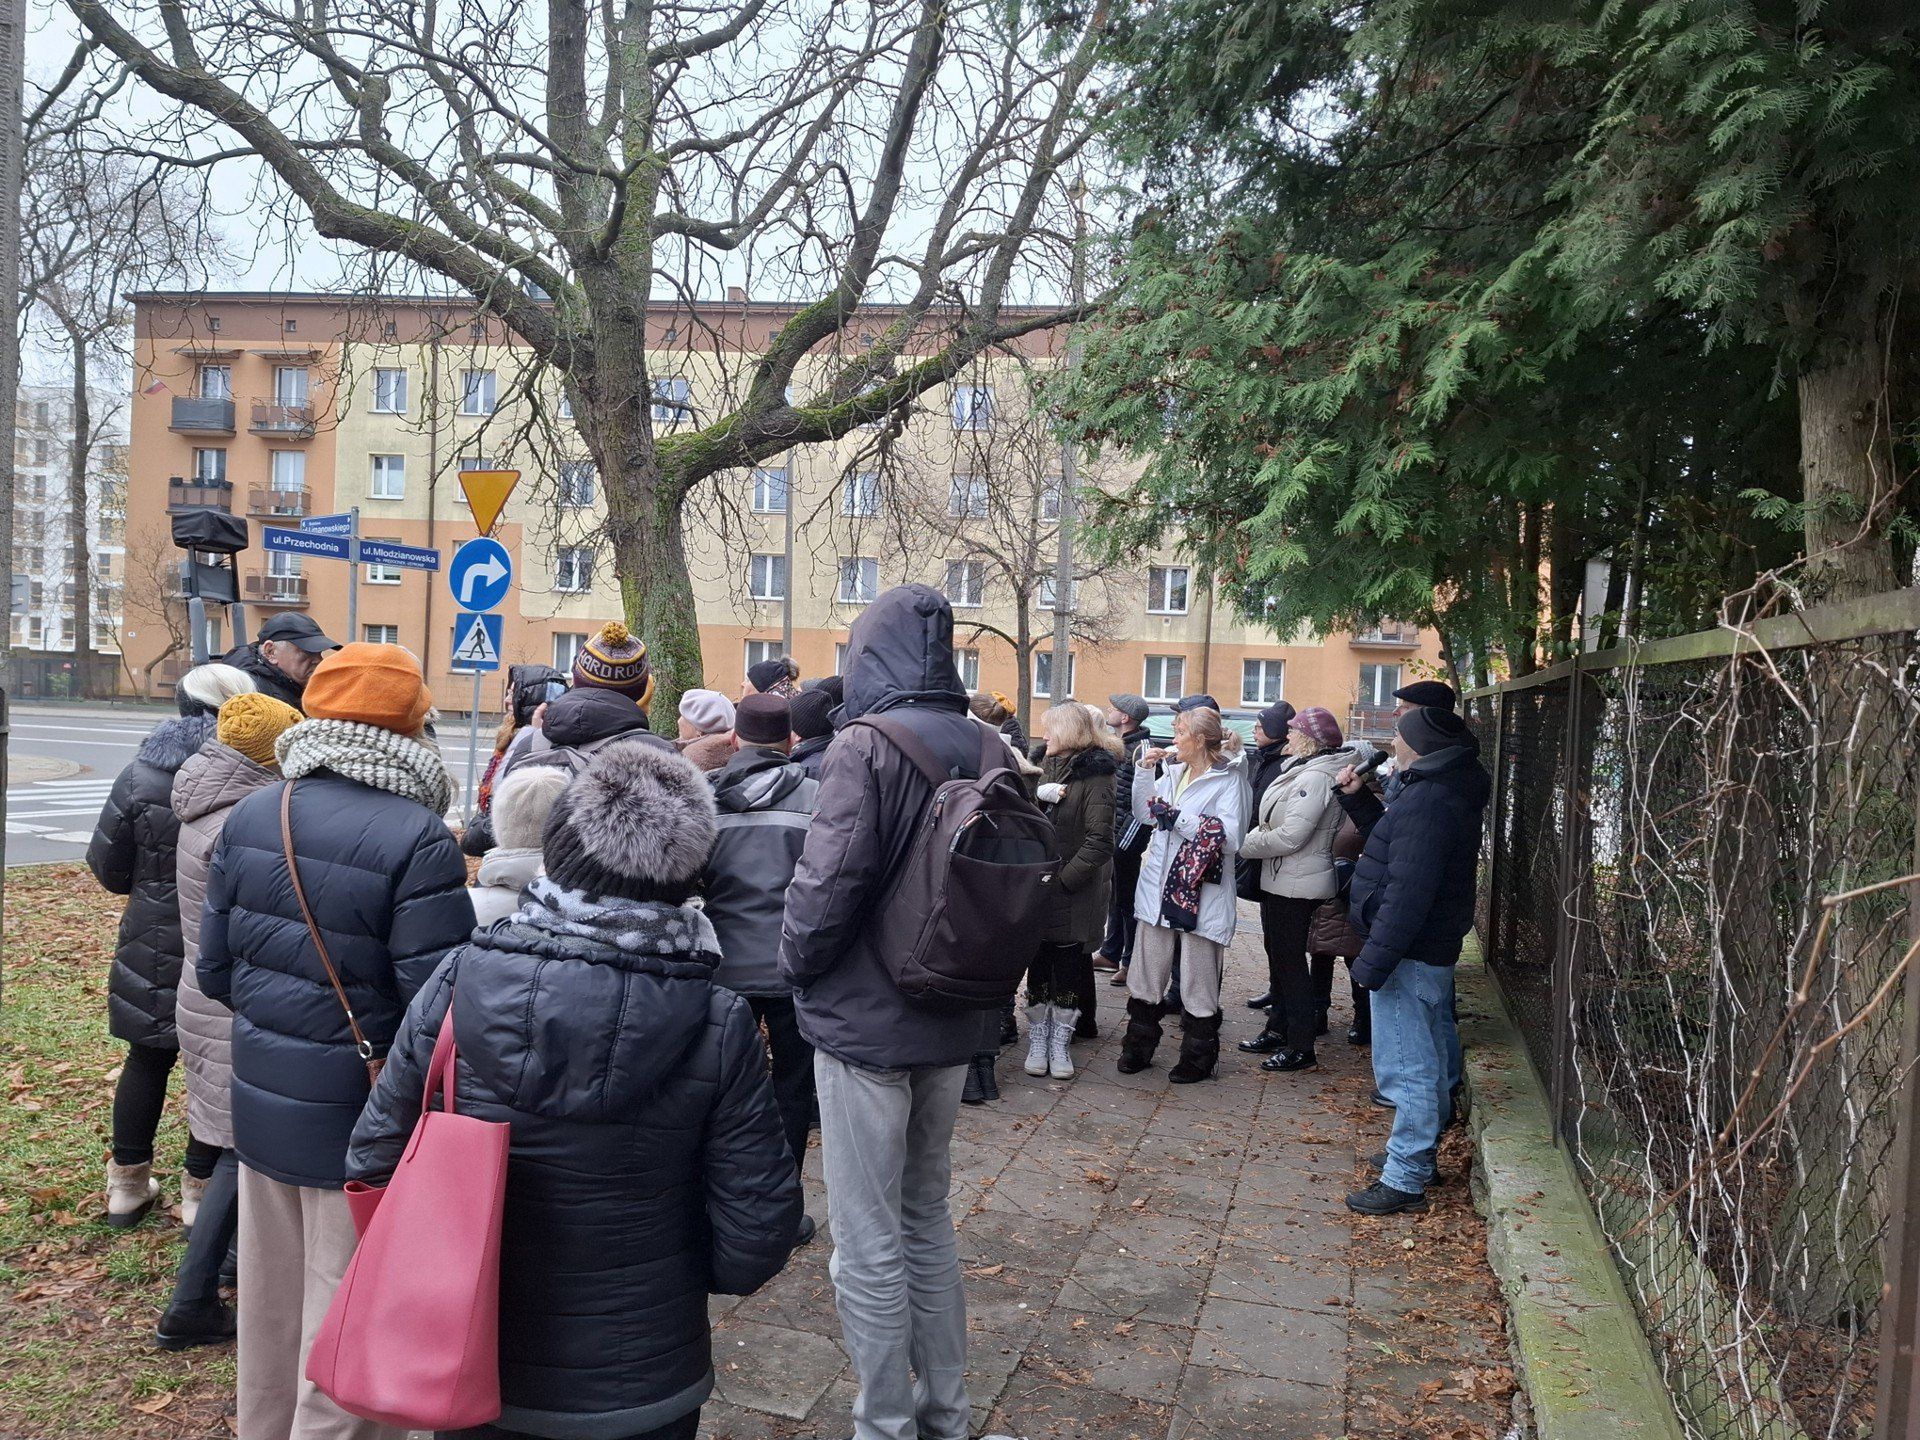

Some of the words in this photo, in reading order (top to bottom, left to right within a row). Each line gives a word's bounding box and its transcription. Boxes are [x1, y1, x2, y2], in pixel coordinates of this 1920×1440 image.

[272, 536, 339, 552] ul.Przechodnia
[362, 547, 436, 563] ul.Młodzianowska
[578, 650, 611, 678] HARD
